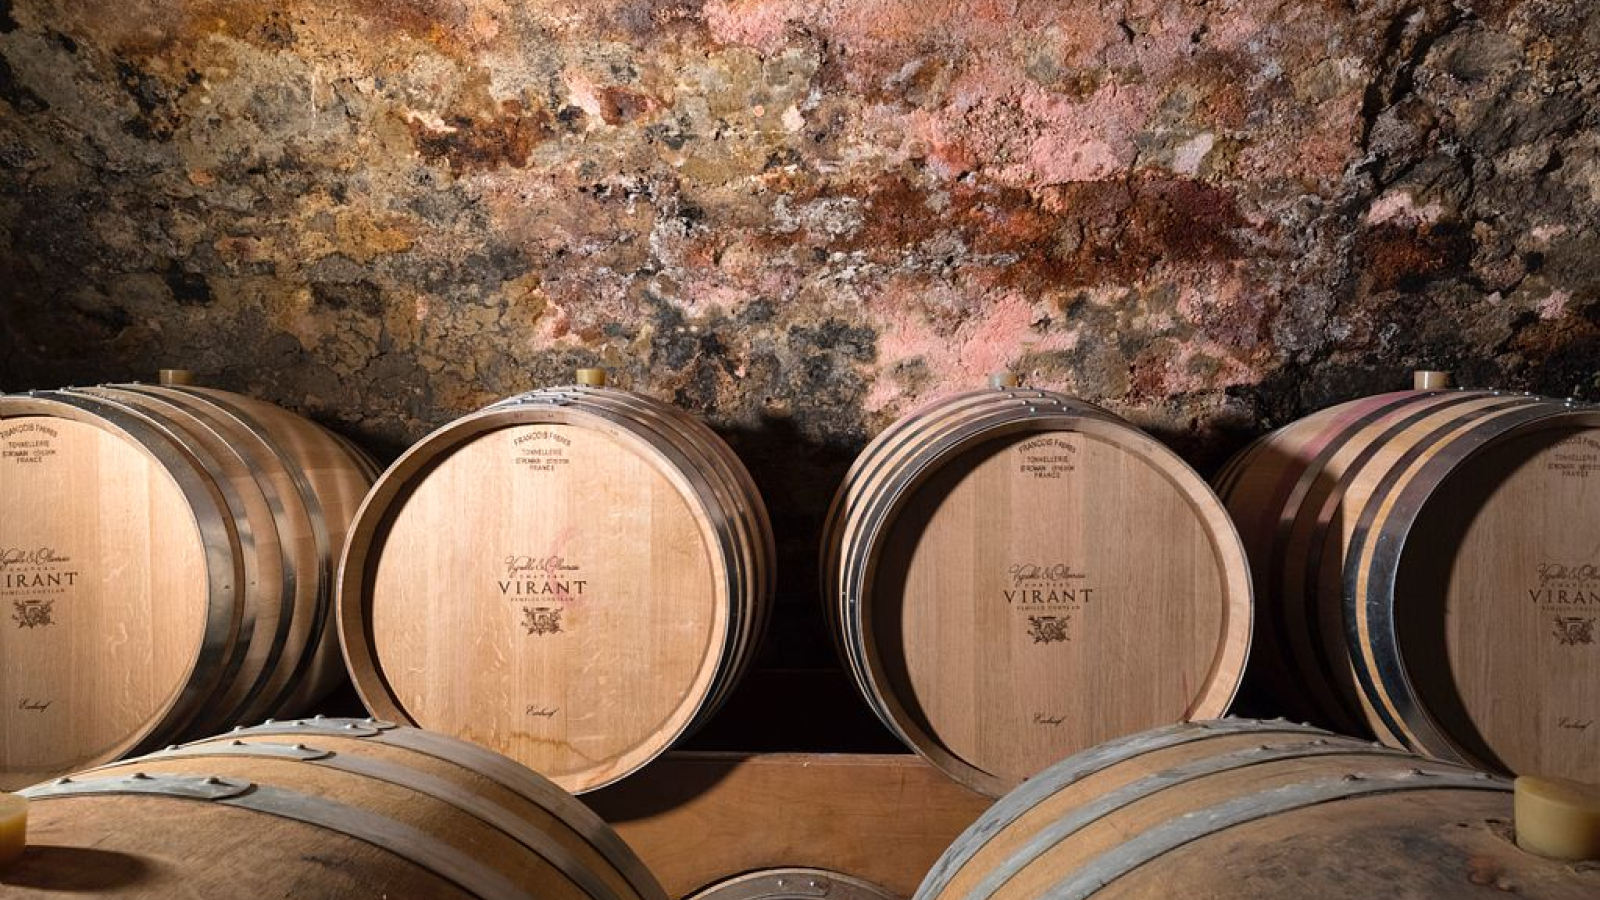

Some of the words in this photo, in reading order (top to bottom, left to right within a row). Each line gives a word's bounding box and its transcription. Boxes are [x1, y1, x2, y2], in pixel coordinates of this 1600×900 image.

[6, 571, 79, 588] IRANT
[498, 580, 587, 595] VIRANT
[1003, 588, 1093, 603] VIRANT
[1528, 589, 1600, 604] VIRAN
